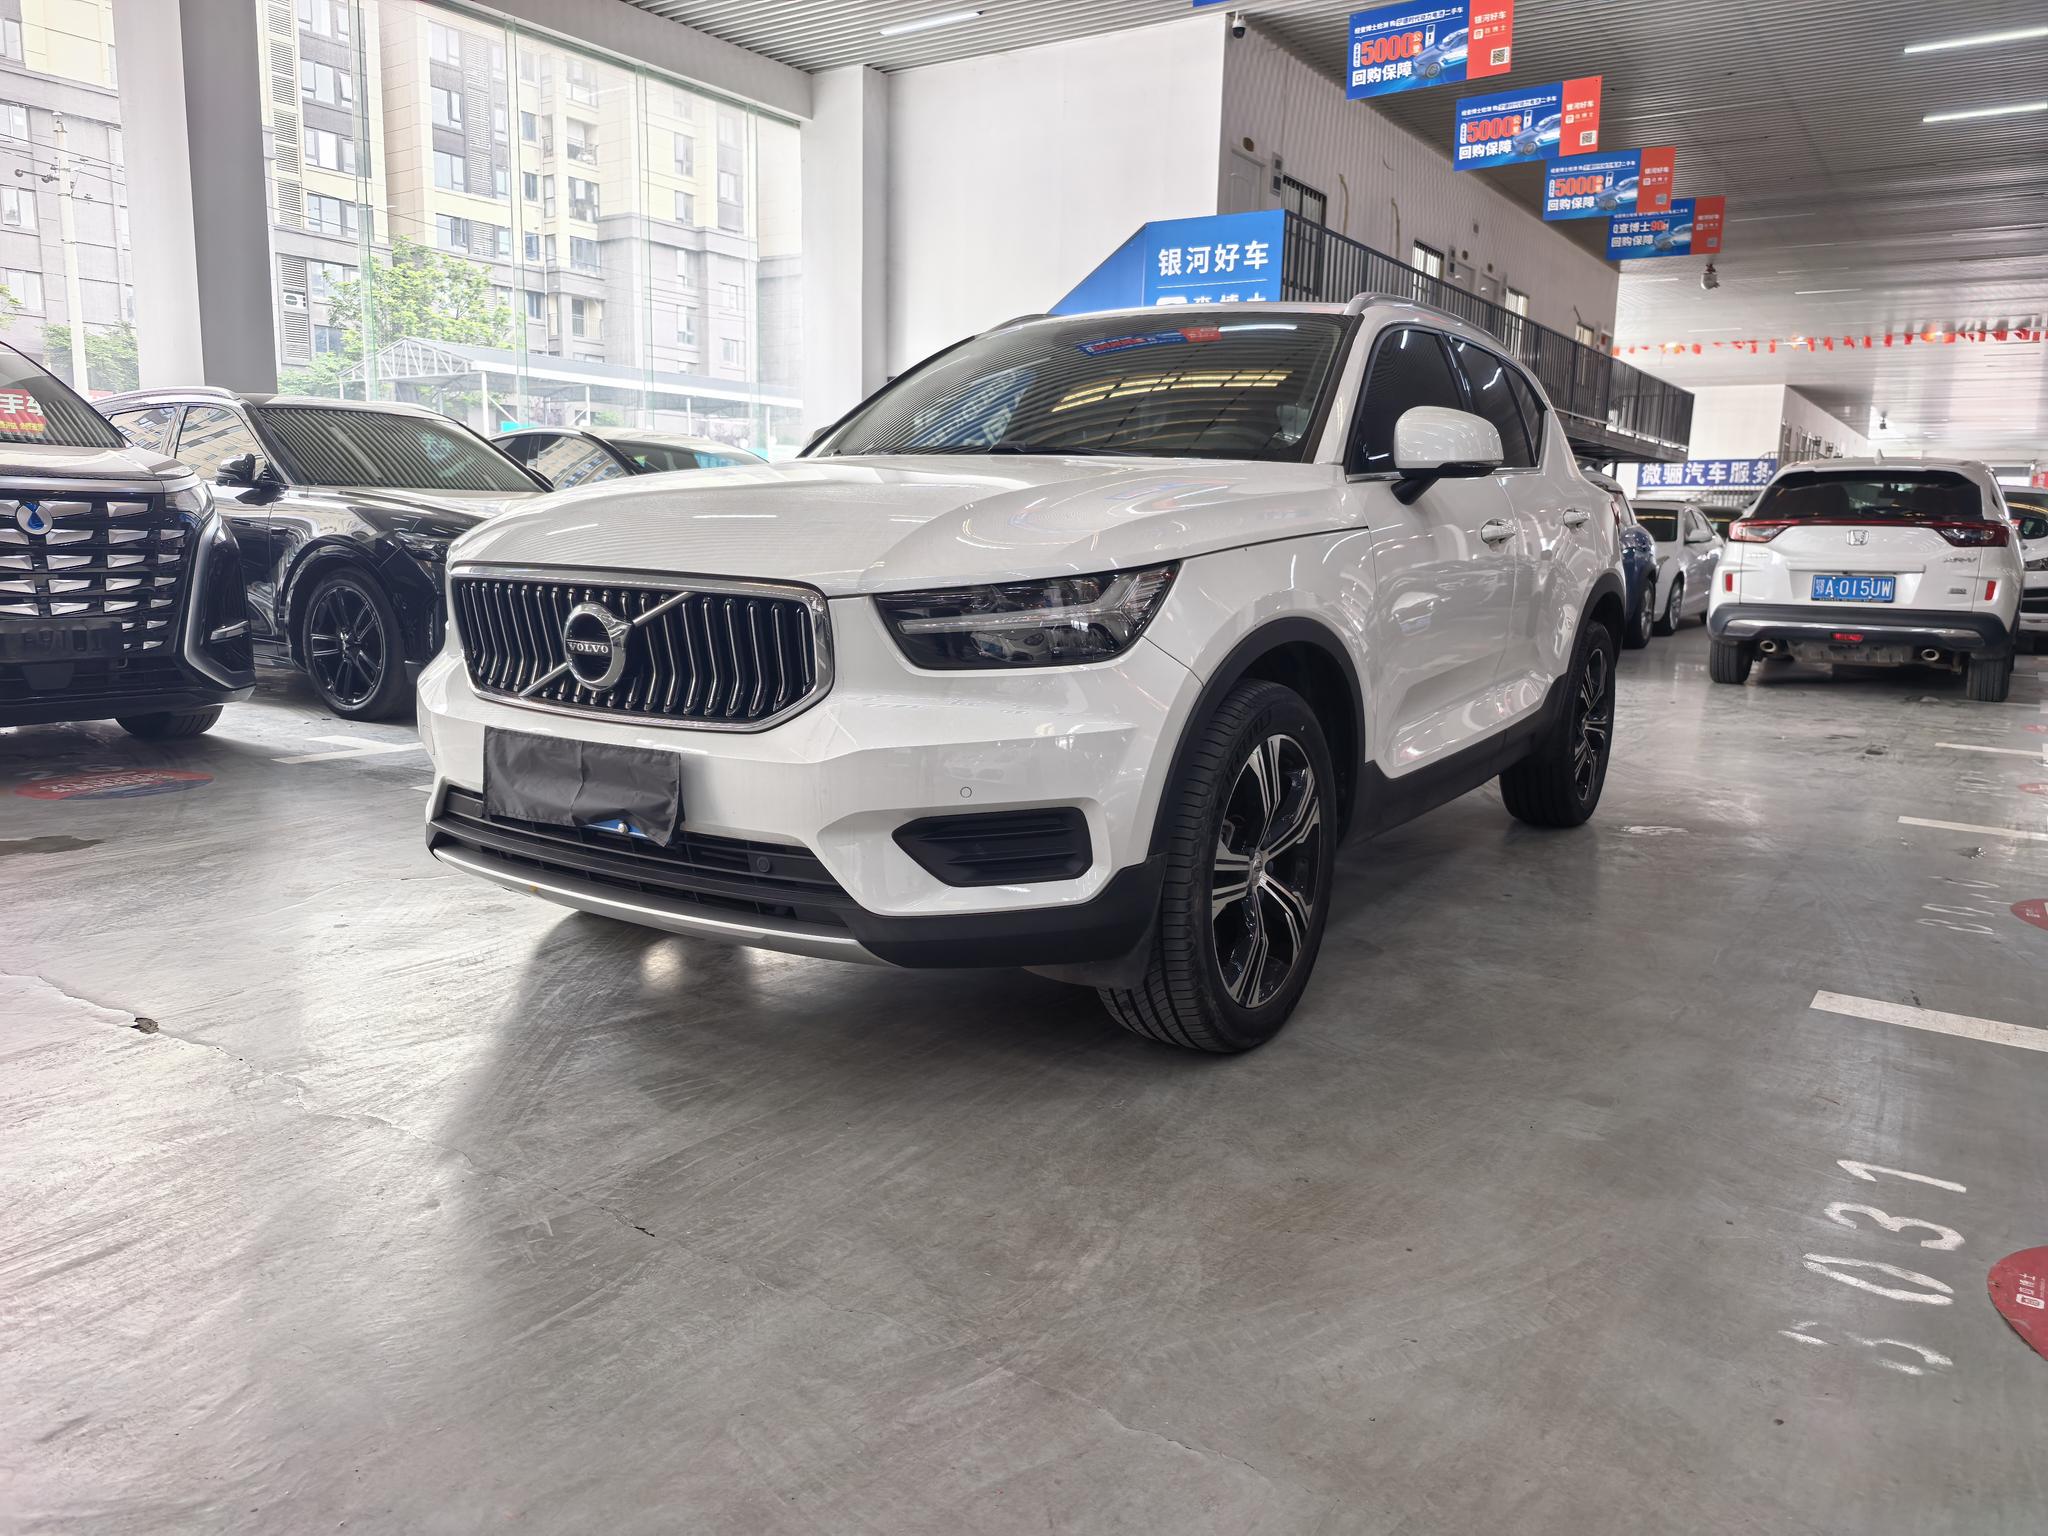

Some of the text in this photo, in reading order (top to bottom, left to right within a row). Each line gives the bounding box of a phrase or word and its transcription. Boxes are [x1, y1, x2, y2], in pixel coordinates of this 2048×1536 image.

[1352, 61, 1413, 87] 回购保障
[1459, 139, 1512, 160] 回购保障
[1547, 196, 1595, 212] 回购保障
[1611, 235, 1654, 248] 回购保障
[1158, 240, 1270, 277] 银河好车
[568, 641, 609, 653] VOLVO
